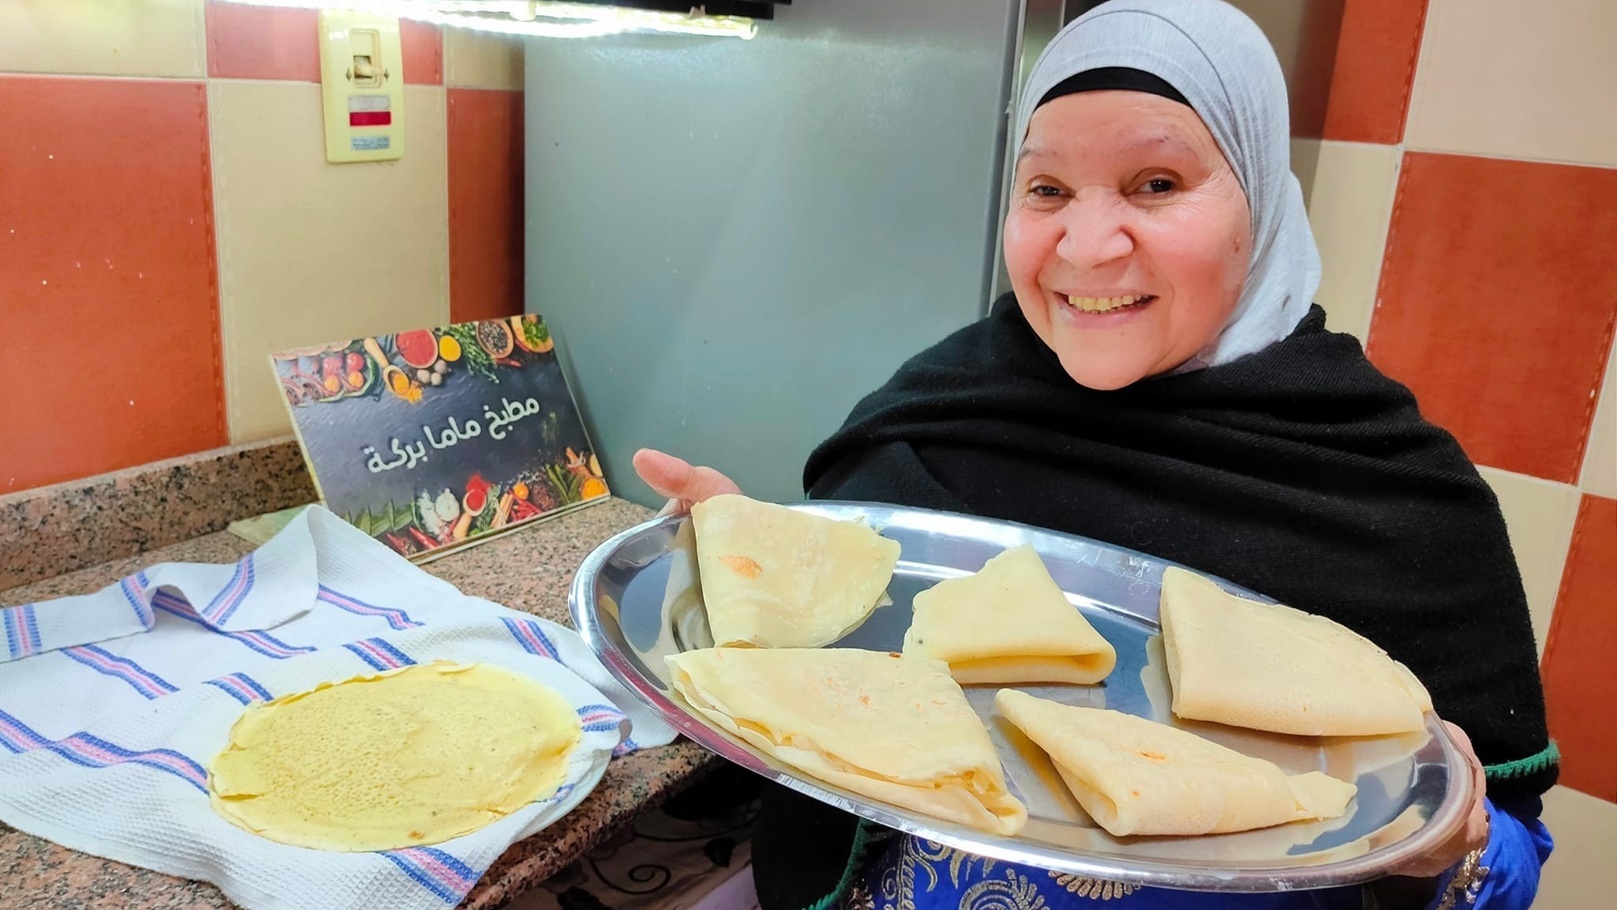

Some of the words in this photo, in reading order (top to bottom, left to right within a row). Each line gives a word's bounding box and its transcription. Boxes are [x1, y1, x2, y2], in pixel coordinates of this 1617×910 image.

[423, 416, 481, 449] ماما
[484, 397, 540, 440] مطبخ
[363, 438, 427, 473] بركة
